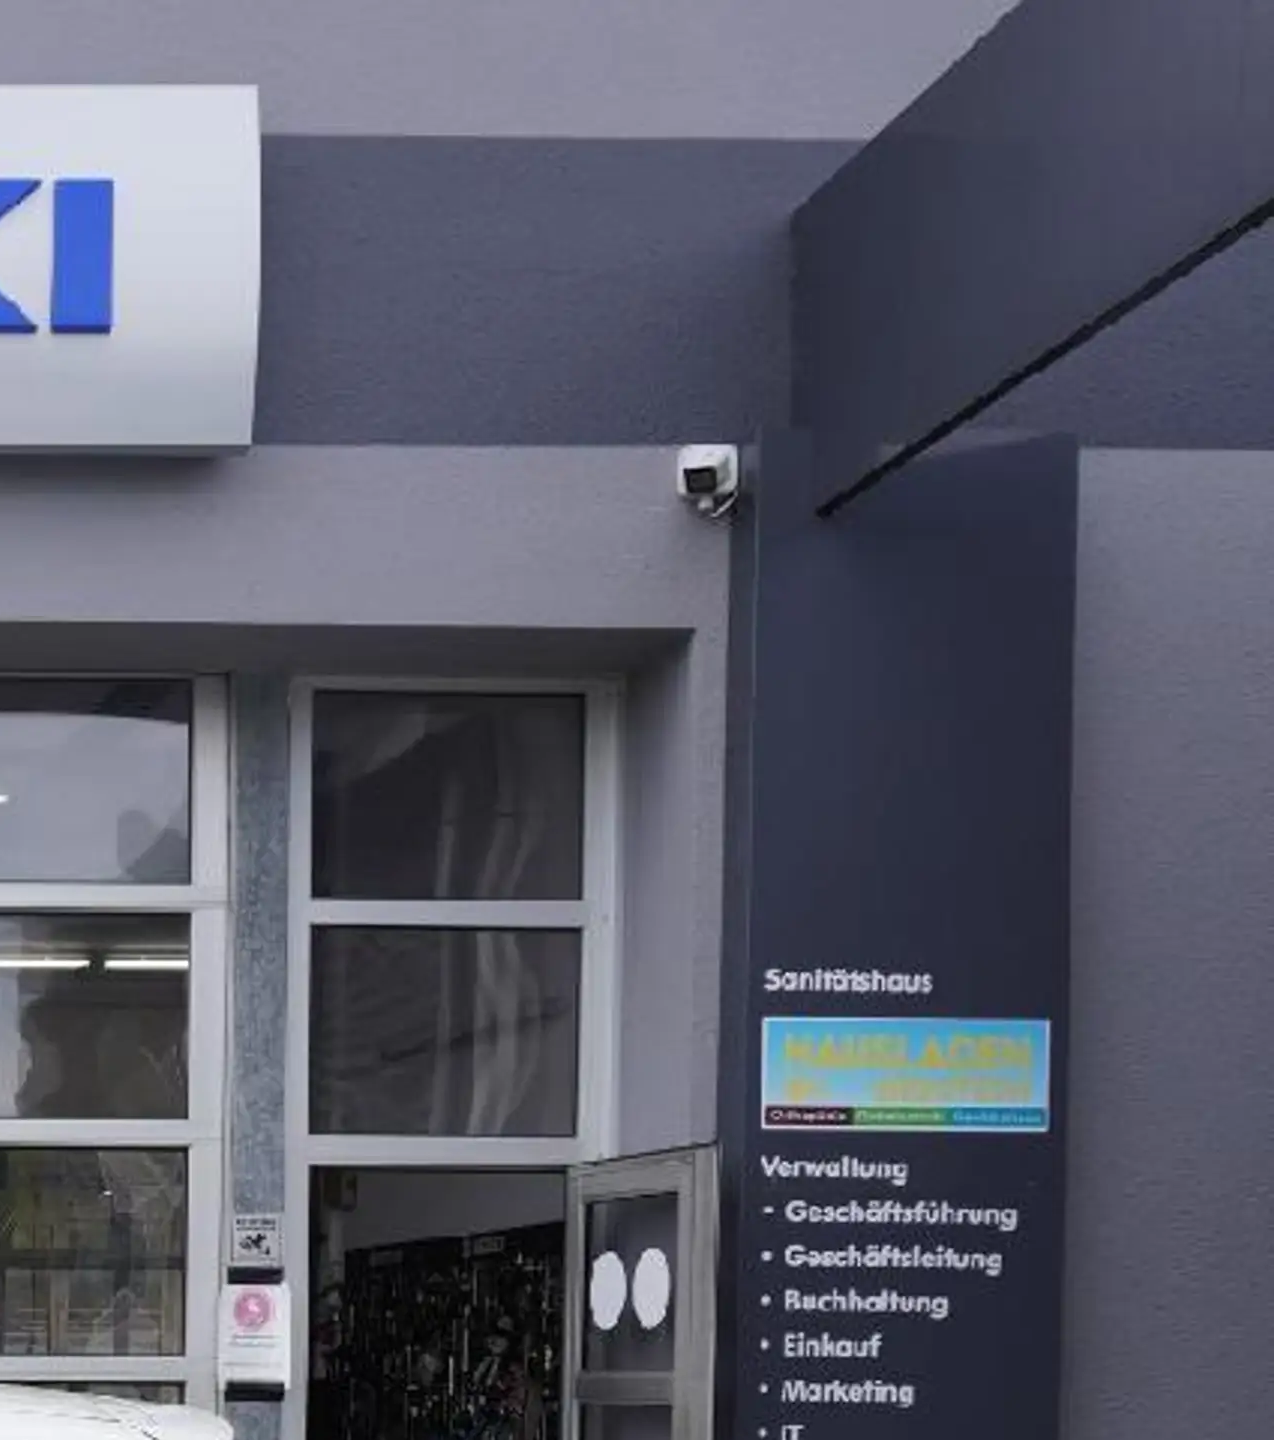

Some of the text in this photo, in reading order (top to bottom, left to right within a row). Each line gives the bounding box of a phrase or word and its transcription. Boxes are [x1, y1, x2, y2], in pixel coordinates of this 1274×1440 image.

[764, 968, 934, 993] Sanitätshaus
[760, 1155, 909, 1187] Verwaltung
[784, 1200, 1018, 1232] Geschäftsführung
[784, 1245, 1003, 1277] Geschäftsleitung
[783, 1289, 949, 1319] Buchhaltung
[783, 1333, 883, 1358] Einkauf
[781, 1380, 915, 1408] Marketing
